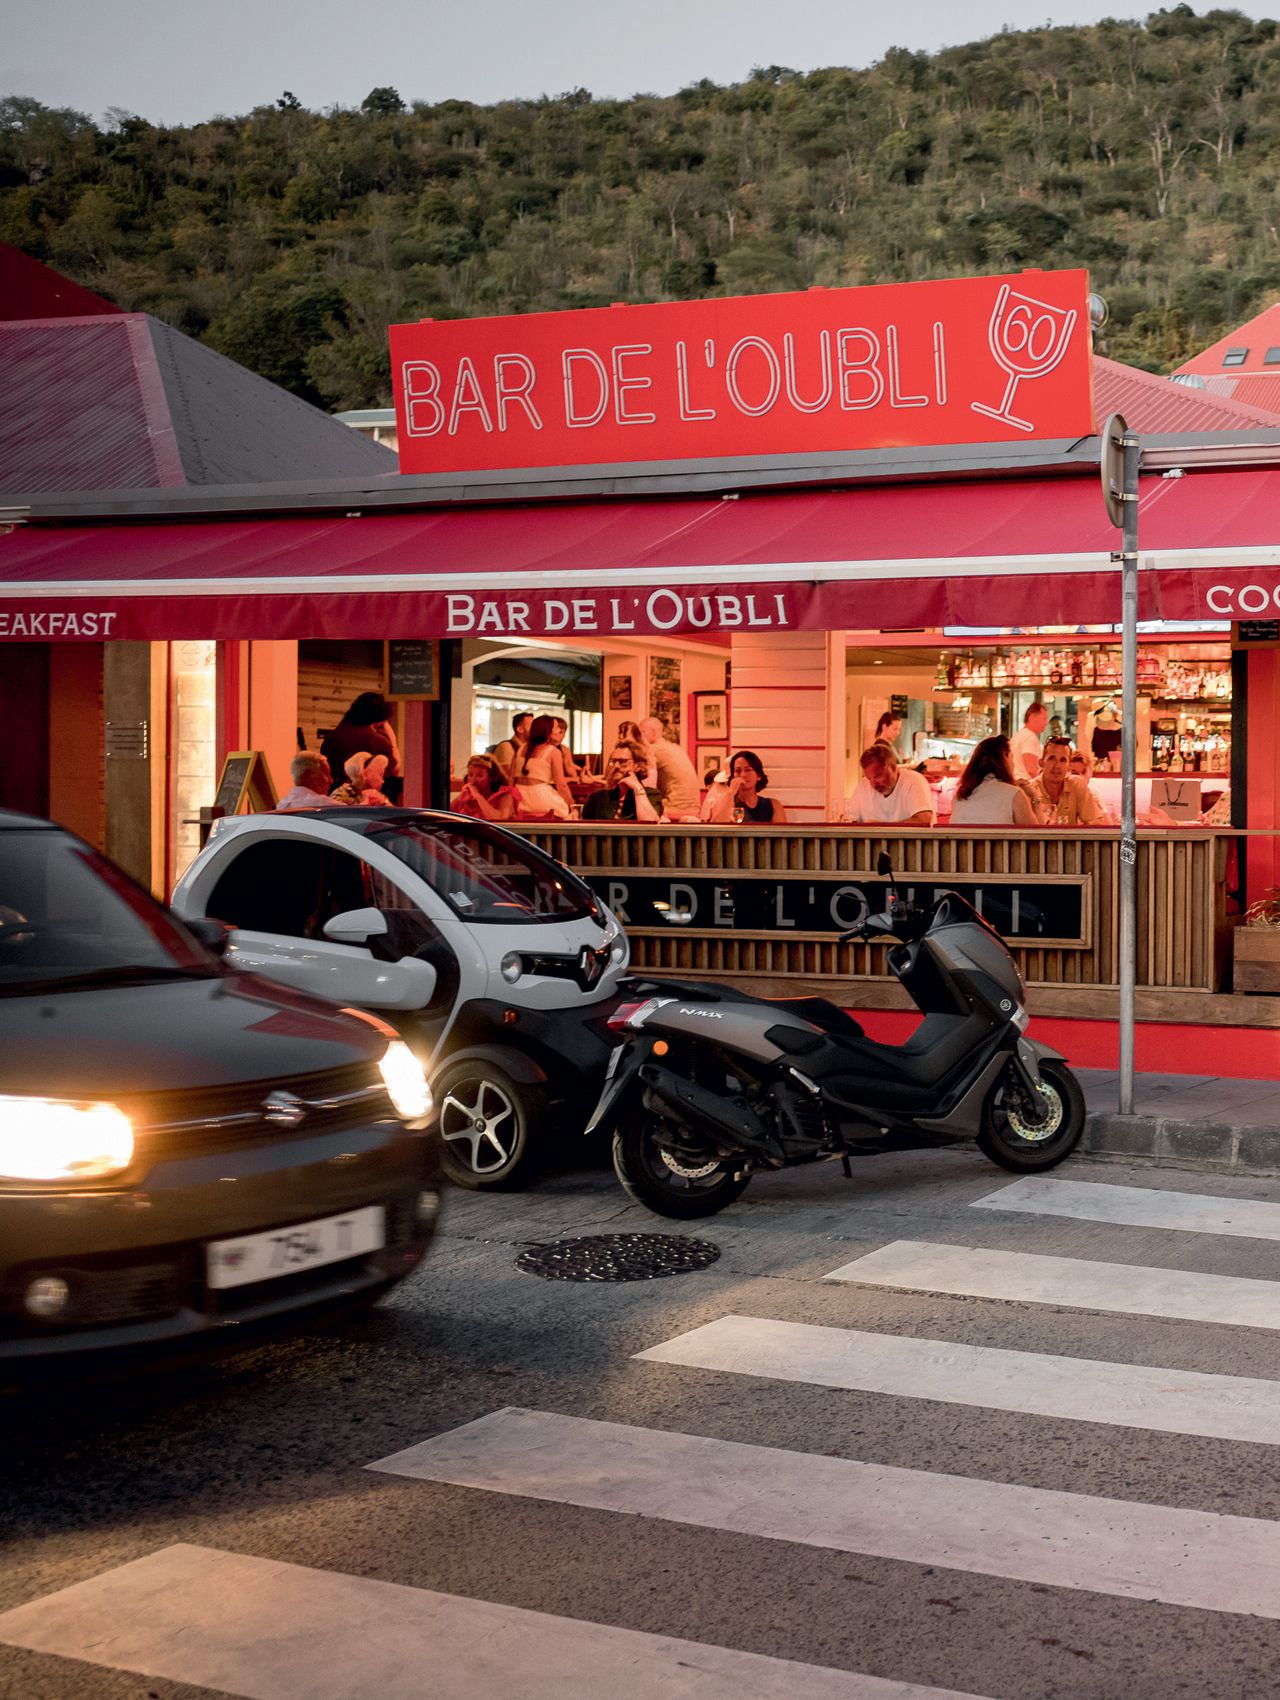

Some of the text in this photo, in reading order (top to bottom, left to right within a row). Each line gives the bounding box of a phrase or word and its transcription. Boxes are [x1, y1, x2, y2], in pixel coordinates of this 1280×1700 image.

[1003, 304, 1057, 361] 60
[402, 321, 949, 438] BAR DE L'OUBLI
[445, 588, 789, 632] BAR DE L'OUBLI
[669, 883, 735, 927] DE
[679, 1007, 725, 1019] NMAX
